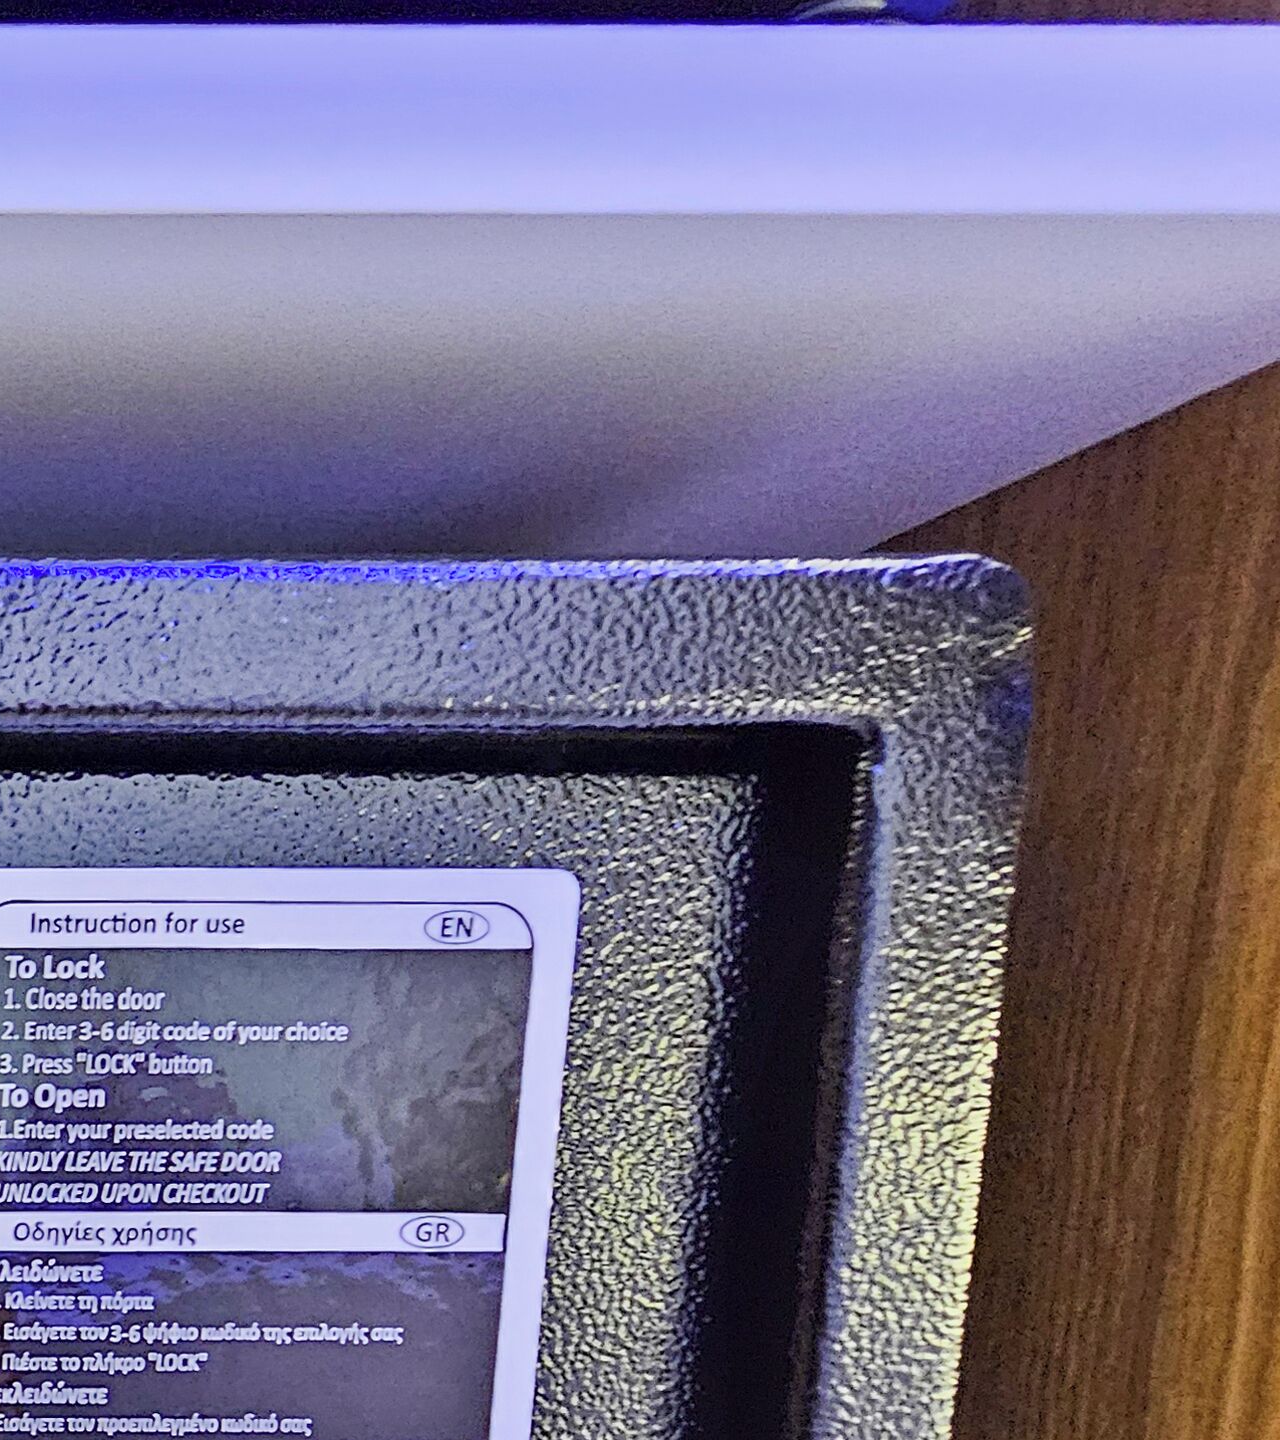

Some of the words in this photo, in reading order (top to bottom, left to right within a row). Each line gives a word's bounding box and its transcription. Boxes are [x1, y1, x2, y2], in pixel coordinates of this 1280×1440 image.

[30, 912, 156, 934] Instruction
[166, 912, 198, 933] for
[206, 918, 245, 934] use
[441, 917, 474, 938] EN
[4, 955, 37, 978] To
[42, 954, 105, 979] Lock
[3, 988, 21, 1010] 1.
[25, 988, 78, 1010] Close
[81, 986, 114, 1010] the
[118, 987, 166, 1010] door
[1, 1022, 20, 1040] 2.
[24, 1022, 76, 1040] Enter
[78, 1022, 114, 1041] 3-6
[116, 1021, 160, 1044] digit
[164, 1022, 210, 1040] code
[214, 1021, 238, 1040] of
[238, 1024, 283, 1044] your
[285, 1021, 349, 1041] choice
[22, 1054, 72, 1074] Press
[76, 1052, 145, 1074] "LOCK"
[148, 1052, 212, 1074] button
[34, 1084, 106, 1112] Open
[66, 1123, 112, 1143] your
[114, 1119, 224, 1143] preselected
[227, 1120, 274, 1140] code
[64, 1152, 126, 1172] LEAVE
[129, 1152, 168, 1172] THE
[168, 1152, 220, 1172] SAFE
[220, 1152, 282, 1172] DOOR
[101, 1183, 161, 1204] UPON
[162, 1183, 270, 1204] CHECKOUT
[14, 1221, 106, 1246] Οδηγίες
[112, 1221, 197, 1246] χρήσης
[416, 1222, 450, 1242] GR
[78, 1295, 98, 1313] τη
[100, 1291, 154, 1314] πόρτα
[79, 1327, 109, 1340] τον
[109, 1326, 140, 1342] 3-6
[261, 1326, 291, 1344] της
[370, 1326, 404, 1344] σας
[60, 1356, 80, 1371] το
[66, 1418, 95, 1432] τον
[280, 1418, 312, 1436] σας
